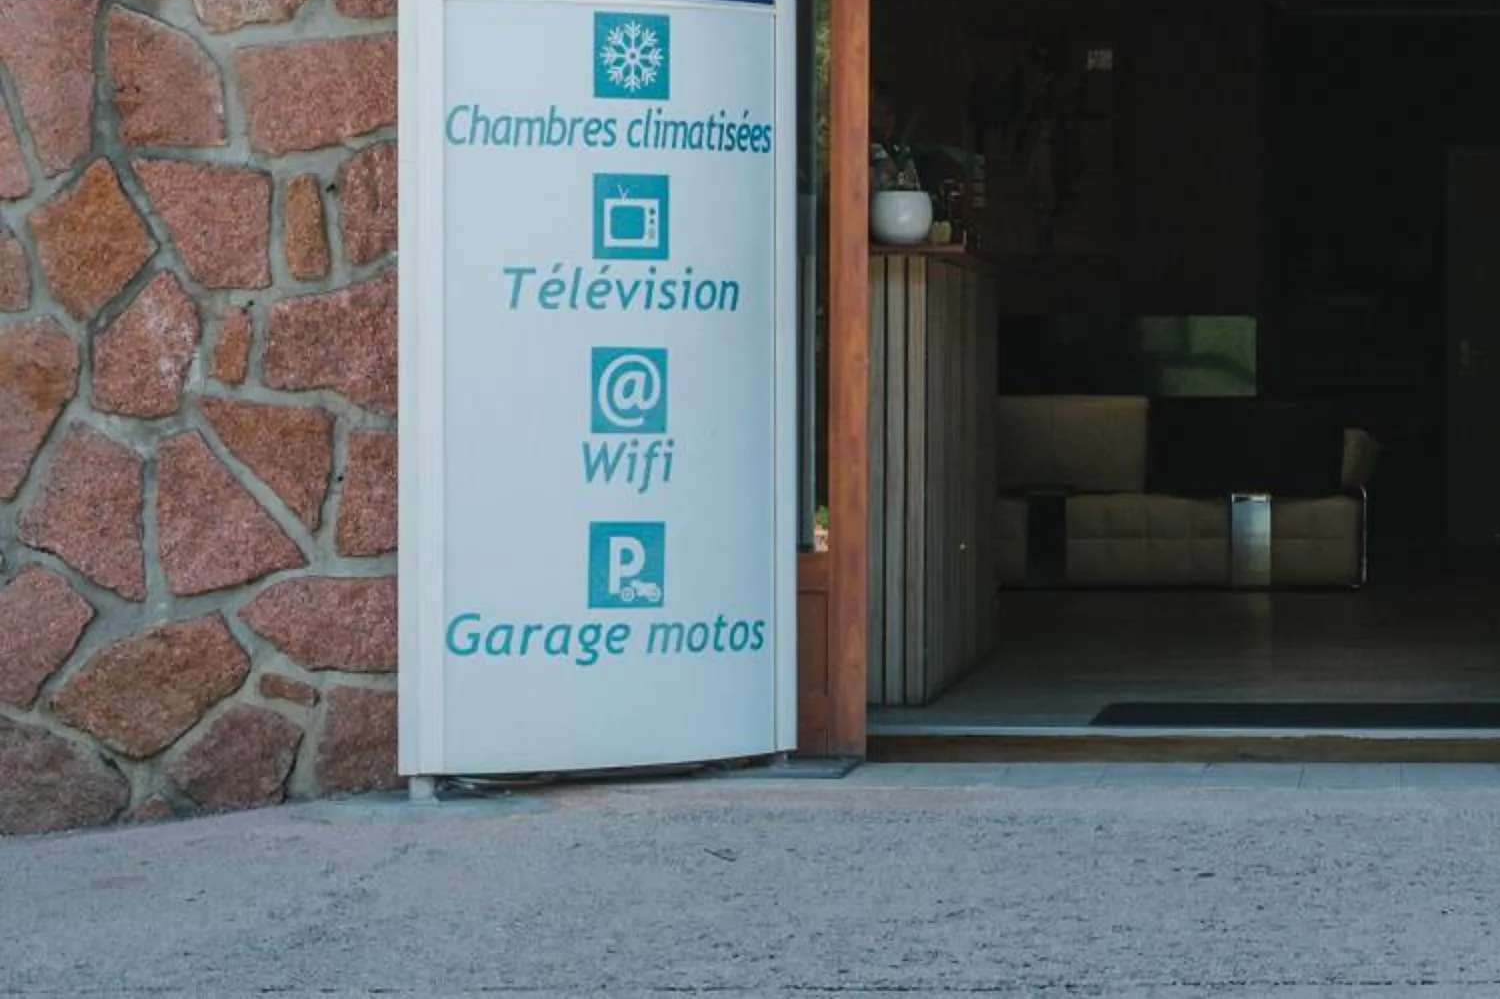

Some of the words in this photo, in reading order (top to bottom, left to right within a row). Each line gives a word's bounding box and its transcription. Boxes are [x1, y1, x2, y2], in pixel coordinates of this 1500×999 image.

[445, 105, 617, 150] Chambres
[626, 107, 772, 154] climatisées
[502, 261, 740, 313] Télévision
[598, 354, 661, 426] @
[581, 438, 675, 494] Wifi
[608, 536, 645, 596] P
[445, 612, 631, 666] Garage
[646, 614, 766, 654] motos
